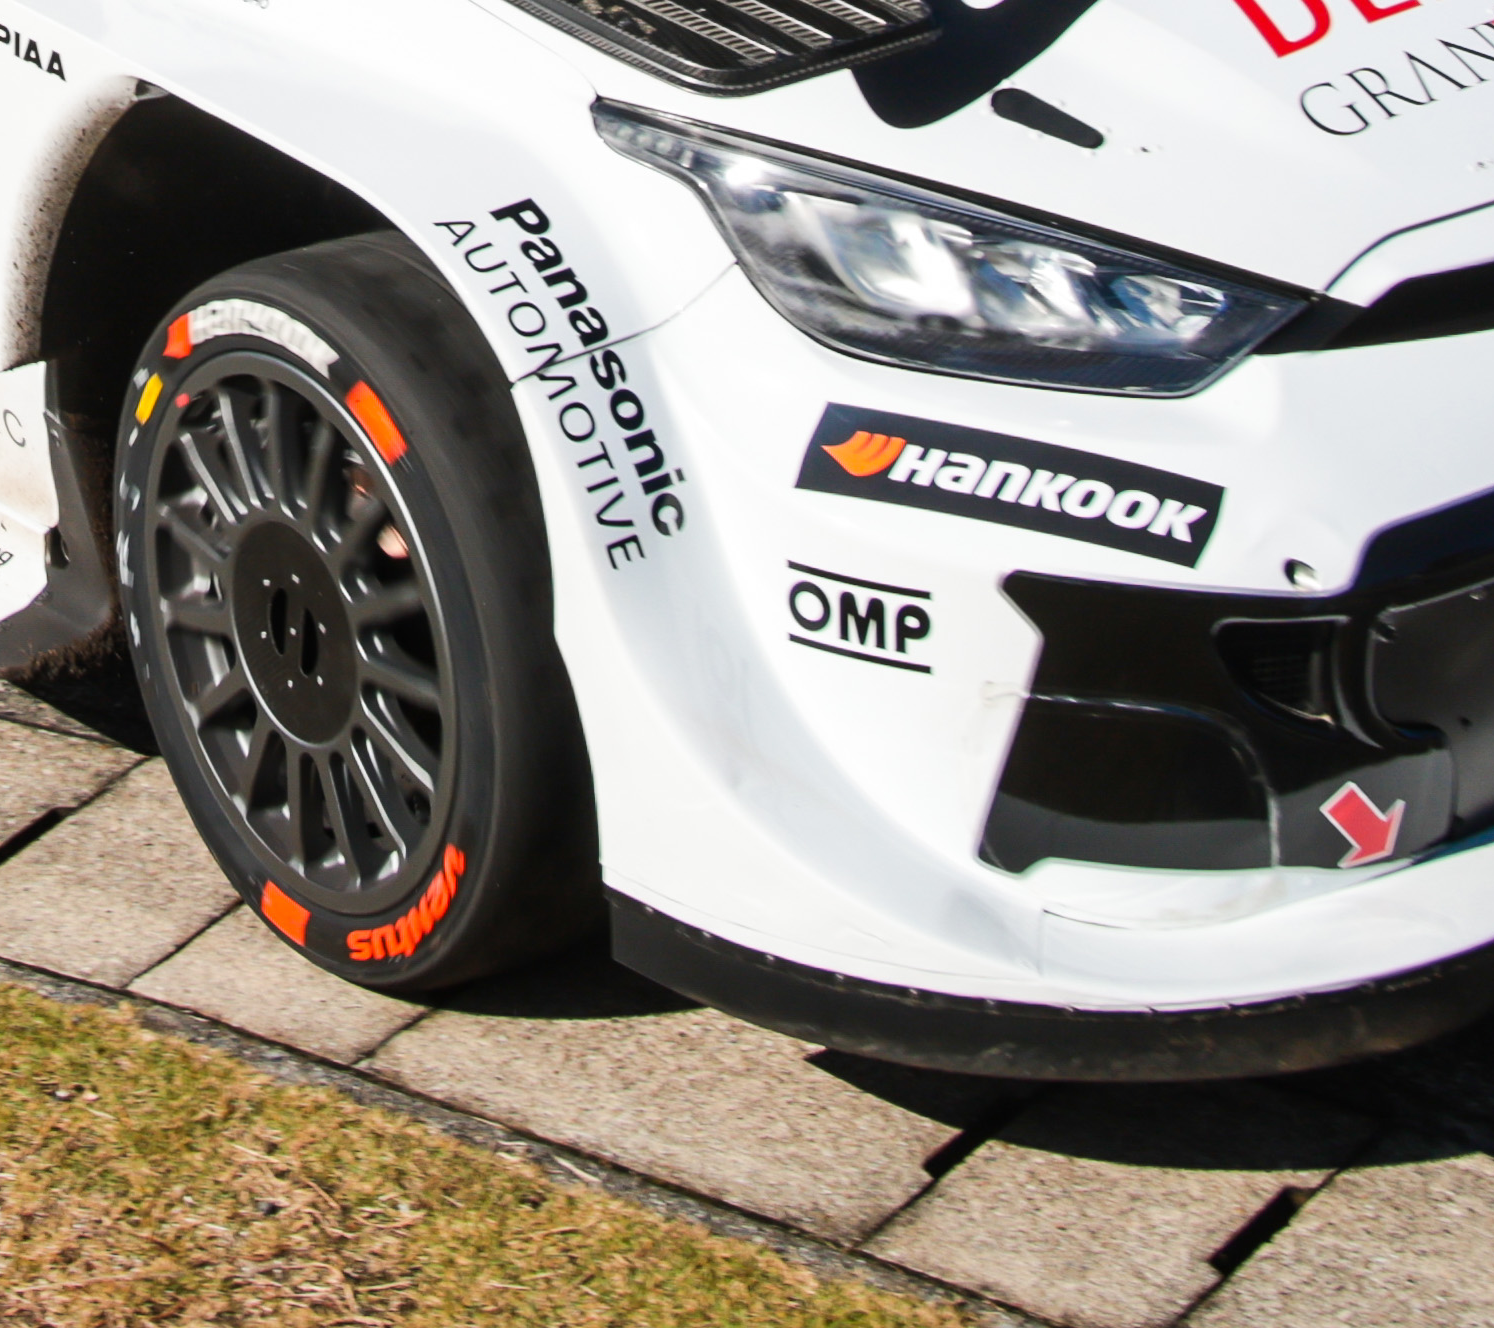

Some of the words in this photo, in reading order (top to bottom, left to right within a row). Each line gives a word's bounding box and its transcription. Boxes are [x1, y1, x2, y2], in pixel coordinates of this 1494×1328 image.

[432, 219, 648, 572] AUTOMOTIVE
[488, 197, 687, 538] Panasonic
[788, 580, 932, 654] OMP
